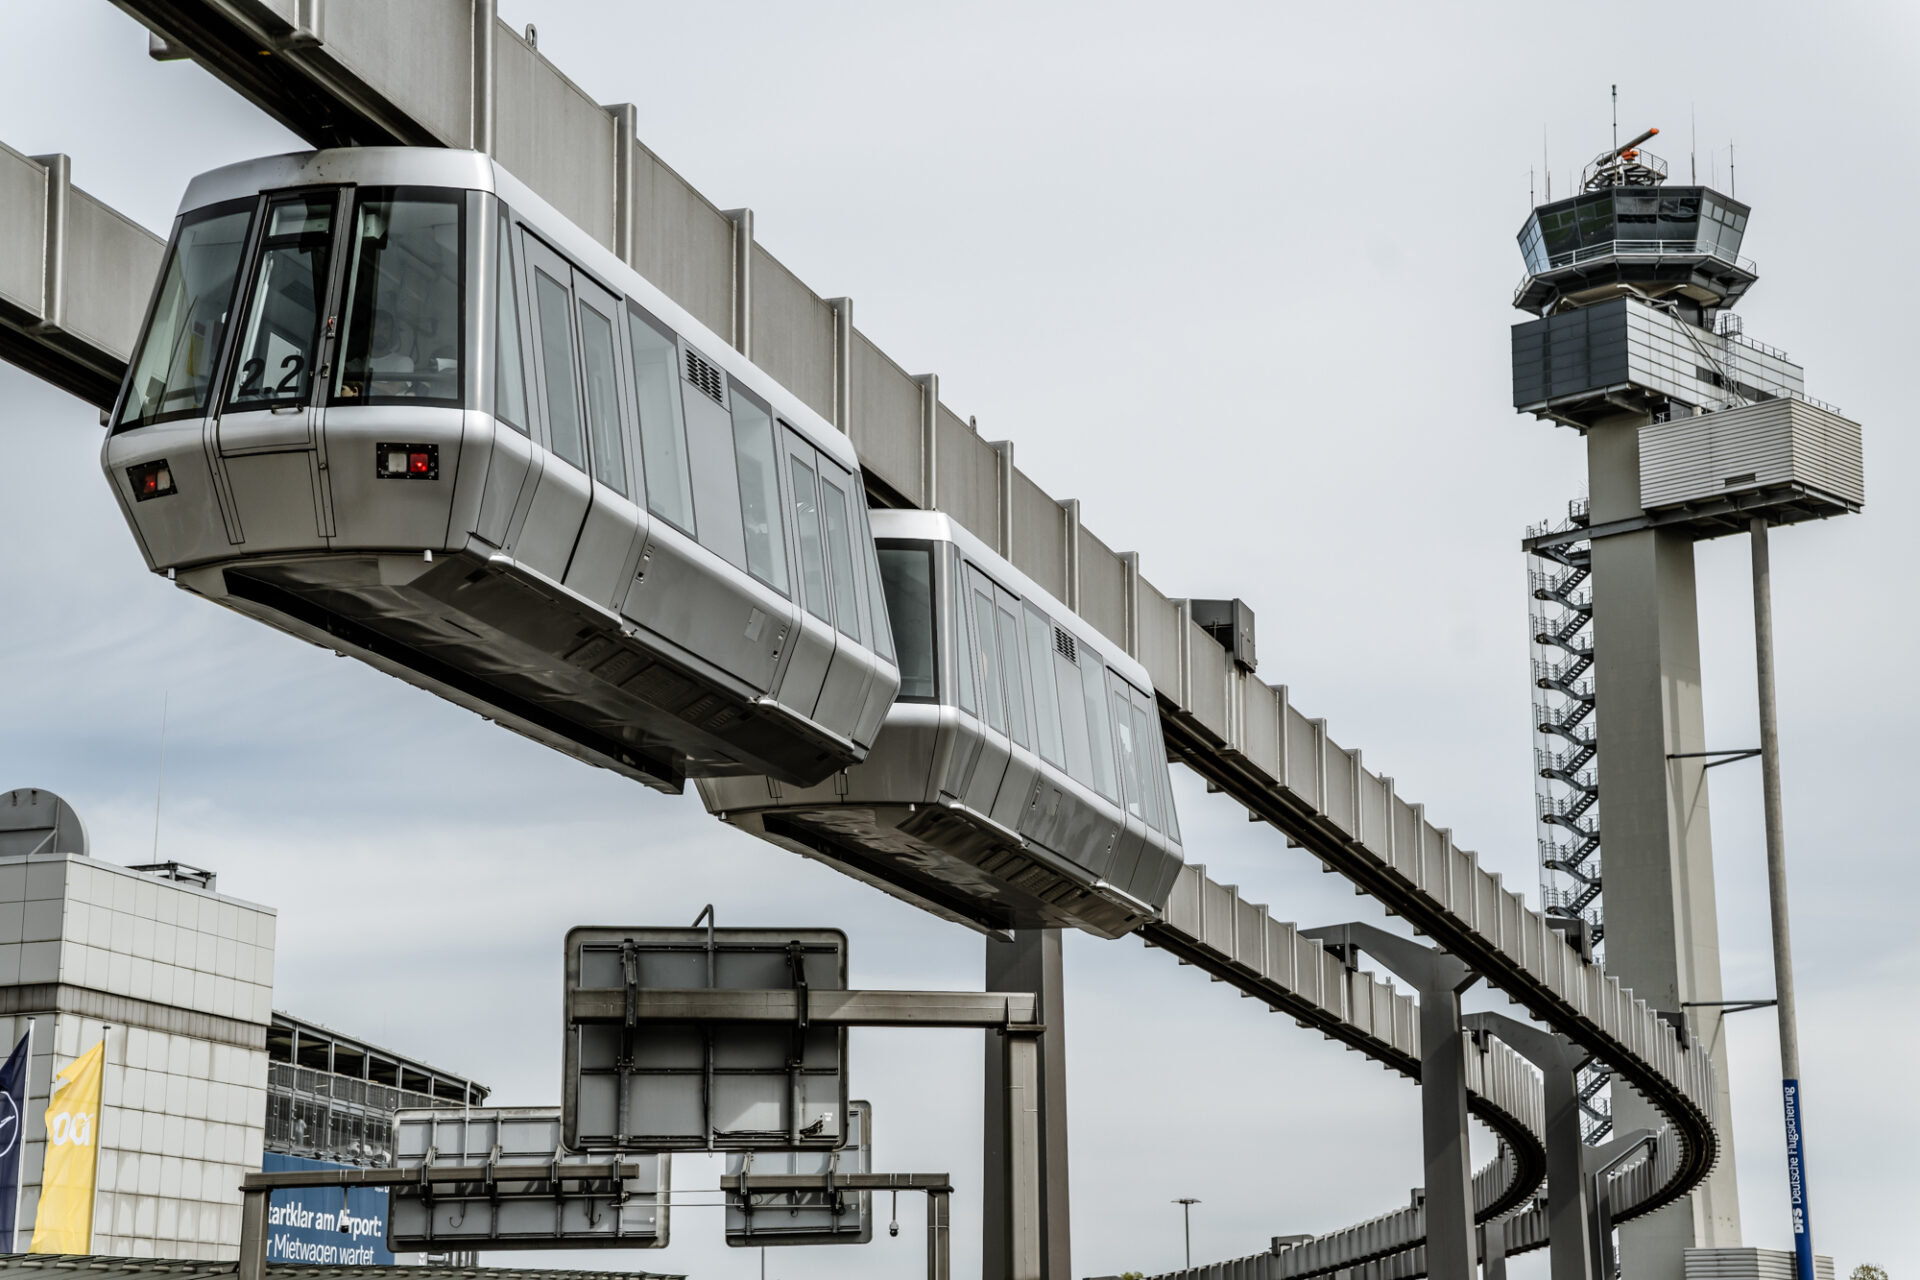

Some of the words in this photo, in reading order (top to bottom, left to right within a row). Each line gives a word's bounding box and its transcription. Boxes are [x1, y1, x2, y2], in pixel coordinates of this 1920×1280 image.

[238, 355, 305, 397] 2.2
[1785, 1086, 1799, 1155] Flugsicherung
[1790, 1157, 1802, 1204] Deutsche
[268, 1201, 314, 1229] tartklar
[315, 1213, 335, 1231] am
[1793, 1208, 1804, 1234] DFS
[274, 1233, 337, 1264] Mietwagen
